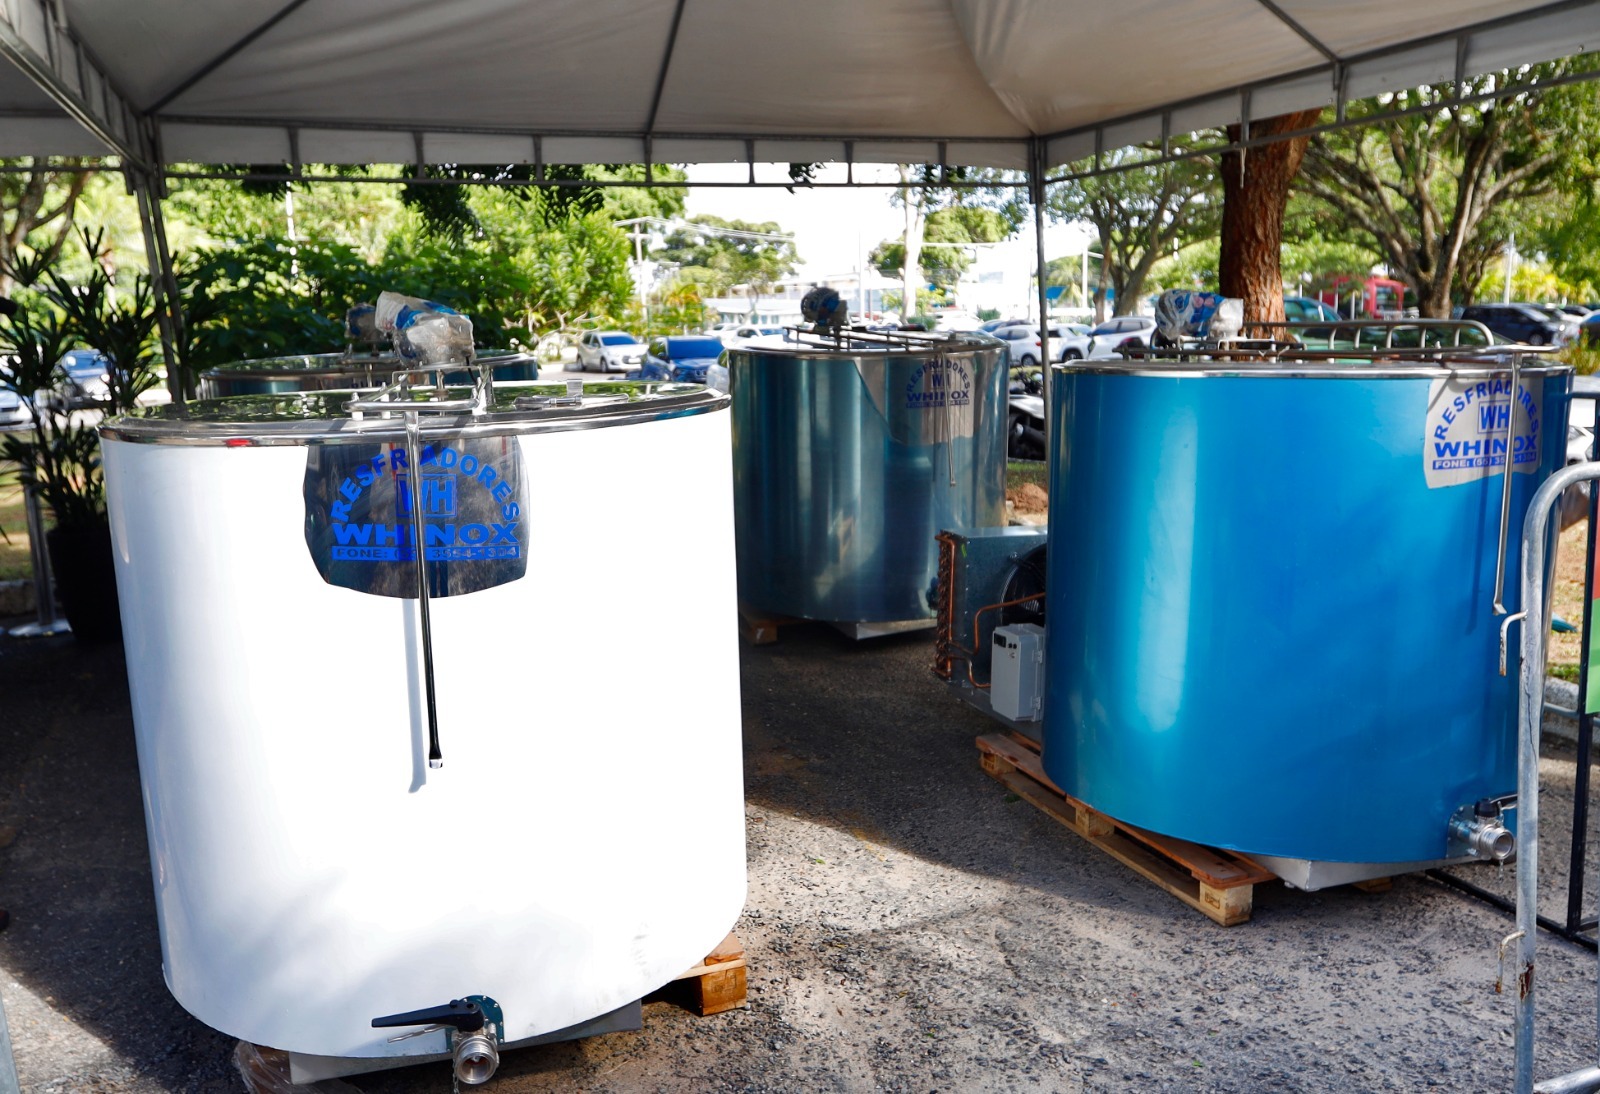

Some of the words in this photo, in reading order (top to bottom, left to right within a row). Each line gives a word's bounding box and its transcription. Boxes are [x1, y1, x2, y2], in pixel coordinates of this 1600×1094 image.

[1481, 404, 1510, 429] WH
[1434, 434, 1537, 457] WHINOX
[1435, 459, 1470, 469] FONE:
[331, 445, 520, 522] RESFRADORES
[399, 480, 453, 512] WH
[332, 522, 519, 545] WHINOX
[337, 548, 388, 558] FONE:
